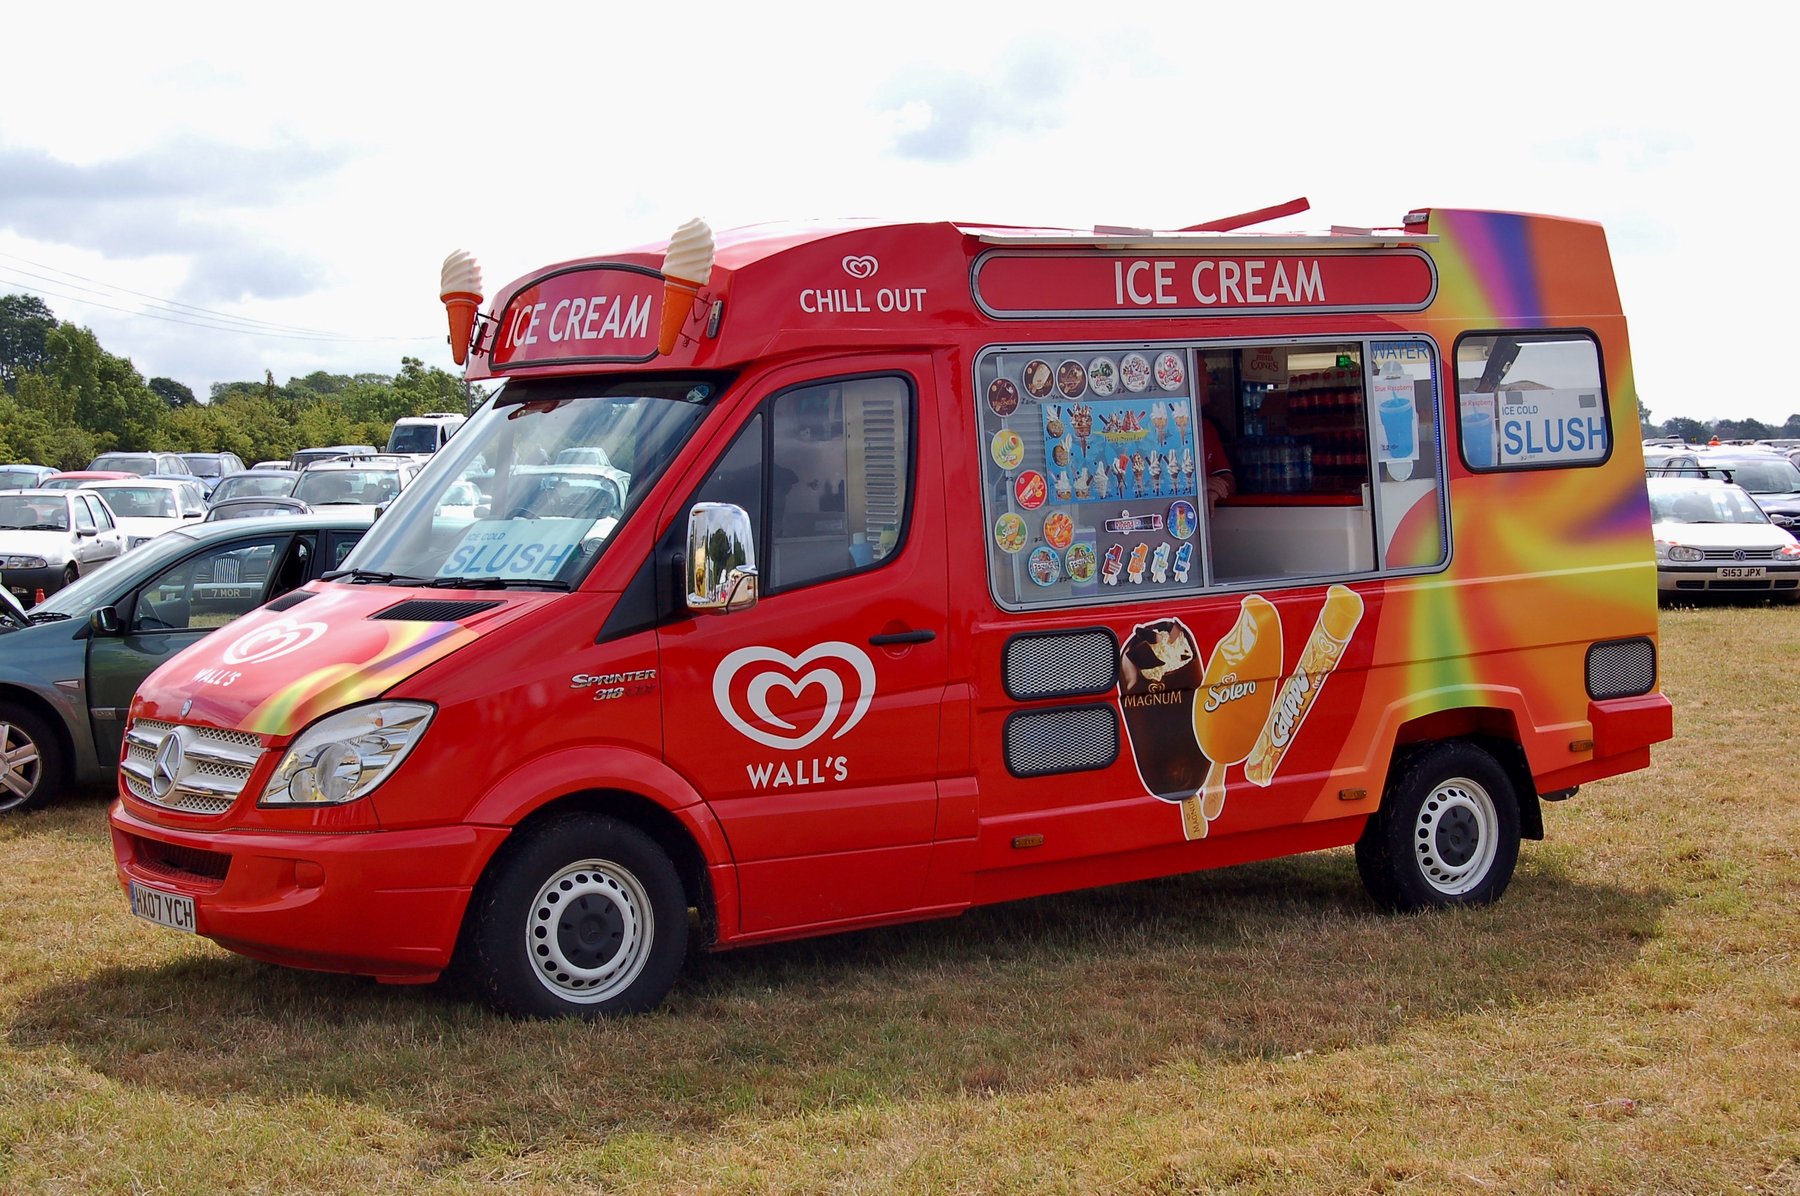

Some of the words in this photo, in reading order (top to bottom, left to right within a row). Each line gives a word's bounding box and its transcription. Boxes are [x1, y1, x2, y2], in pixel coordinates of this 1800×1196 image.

[1114, 260, 1177, 305] ICE
[1192, 260, 1326, 304] CREAM
[799, 289, 871, 313] CHILL
[876, 288, 927, 312] OUT
[504, 302, 546, 349] ICE
[548, 294, 653, 342] CREAM
[1370, 341, 1428, 360] WATER
[1502, 406, 1515, 416] ICE
[1516, 405, 1539, 415] COLD
[1503, 416, 1607, 456] SLUSH
[482, 531, 507, 541] COLD
[442, 543, 575, 575] SLUSH
[1722, 568, 1742, 577] S153
[1744, 567, 1761, 577] JPX
[211, 588, 218, 598] 7
[220, 587, 241, 598] MOR
[192, 667, 243, 687] WALL'S
[570, 669, 656, 688] SPRINTER
[593, 686, 625, 701] 318
[1124, 689, 1183, 708] MAGNUM
[1203, 679, 1257, 713] Solero
[1270, 667, 1310, 748] Calippo
[746, 755, 849, 790] WALL'S
[135, 884, 163, 921] HX07
[165, 890, 195, 930] YCH
